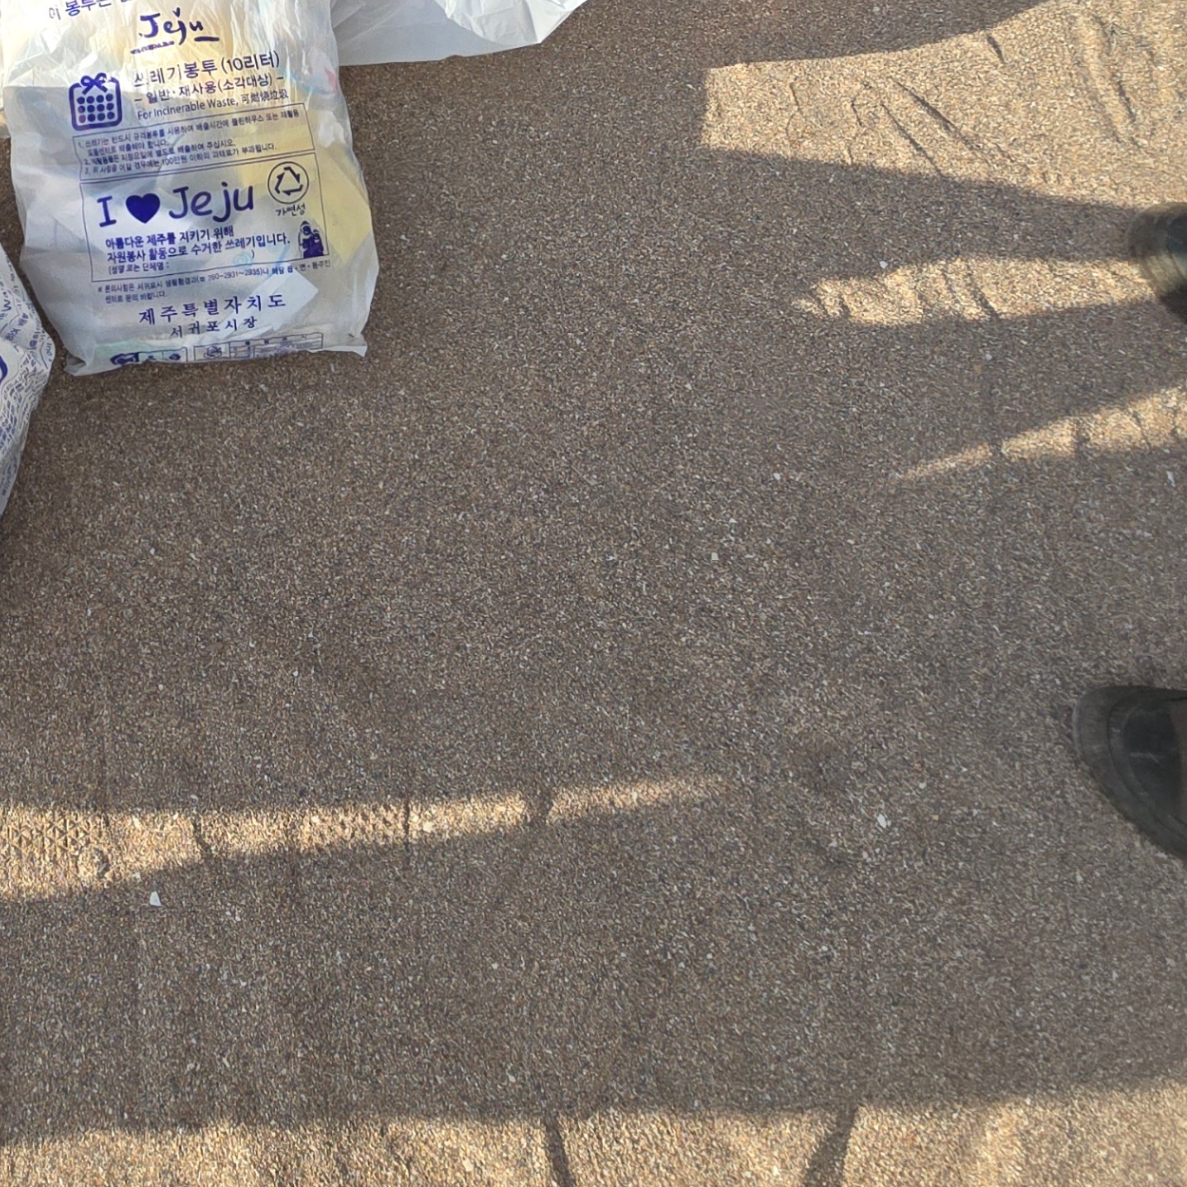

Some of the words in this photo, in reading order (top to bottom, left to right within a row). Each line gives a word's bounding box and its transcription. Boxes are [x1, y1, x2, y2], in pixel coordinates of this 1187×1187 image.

[138, 7, 204, 45] Jeju
[221, 51, 280, 74] (10리터)
[137, 109, 152, 121] For
[153, 100, 205, 118] Incinerable
[207, 95, 239, 110] Waste,
[97, 196, 117, 227] I
[168, 181, 255, 223] Jeju
[105, 235, 144, 250] 아름다운
[146, 232, 176, 247] 제주를
[179, 228, 211, 243] 지키기
[213, 226, 234, 240] 위해
[107, 249, 146, 263] 자원봉사
[149, 245, 188, 261] 활동으로
[191, 241, 222, 256] 수거한
[224, 234, 291, 251] 쓰레기입니다.
[138, 294, 286, 325] 제주특별자치도
[170, 316, 257, 338] 서귀포시장
